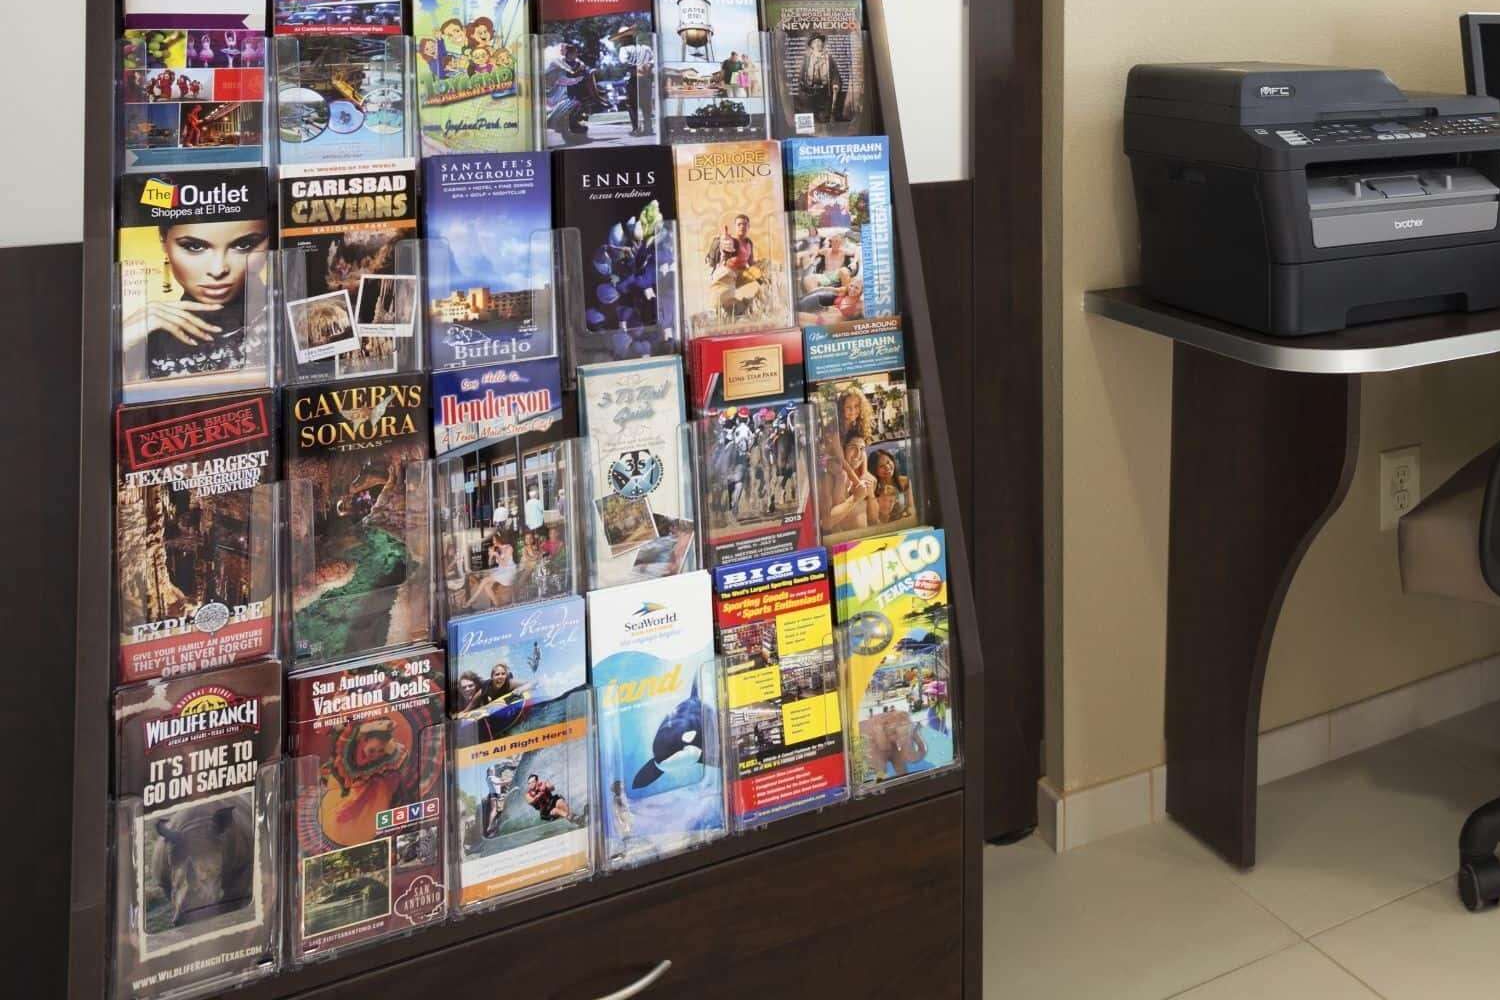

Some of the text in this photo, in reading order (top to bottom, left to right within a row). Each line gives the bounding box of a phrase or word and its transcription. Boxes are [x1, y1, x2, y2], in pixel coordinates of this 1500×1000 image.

[782, 21, 858, 31] NEW MEXICO
[1260, 86, 1290, 97] MFC
[693, 150, 766, 168] EXPLORE
[798, 142, 883, 156] SCHLITTERBAHN
[441, 159, 533, 173] SANTA FE'S
[441, 168, 536, 182] PLAYGROUND
[688, 163, 772, 182] DEMING
[291, 175, 407, 199] CARLSBAD
[582, 170, 656, 188] ENNIS
[146, 188, 171, 201] The
[180, 182, 249, 206] Outlet
[614, 188, 652, 200] tradition
[151, 204, 241, 219] Shoppes at El Paso
[291, 193, 408, 223] CAVERNS
[312, 224, 360, 233] NATIONAL
[1393, 217, 1425, 230] brother
[853, 319, 897, 331] YEAR-ROUND
[455, 338, 532, 360] Buffalo
[810, 335, 896, 355] SCHLITTERBAHN
[294, 384, 422, 423] CAVERNS
[441, 388, 552, 427] Henderson
[140, 408, 253, 442] NATURAL BRIDGE
[301, 412, 419, 449] SONORA
[140, 417, 257, 458] CAVERNS
[338, 440, 383, 452] TEXAS
[125, 450, 270, 489] TEXAS' LARGEST
[172, 467, 261, 492] UNDERGROUND
[783, 514, 802, 524] 2013
[723, 555, 822, 587] BIG 5
[846, 533, 942, 603] WACO
[721, 592, 731, 600] The
[723, 598, 761, 613] Sporting
[762, 591, 789, 604] Goods
[875, 576, 915, 609] TEXAS
[519, 606, 580, 639] Kingdom
[624, 611, 679, 633] SeaWorld
[742, 605, 773, 619] Sports
[133, 636, 263, 673] THEY'LL NEVER FORGET!
[154, 648, 176, 658] YOUR
[178, 640, 206, 653] FAMILY
[220, 629, 263, 643] ADVENTURE
[161, 652, 237, 678] OPEN DAILY
[312, 658, 431, 697] San Antonio 2013
[312, 676, 432, 717] Vacation Deals
[145, 699, 258, 750] WILDLIFE RANCH
[313, 720, 323, 730] ON
[352, 708, 382, 721] SHOPPING
[383, 707, 390, 715] &
[390, 698, 431, 713] ATTRACTIONS
[470, 749, 490, 761] It's
[492, 743, 507, 755] All
[509, 735, 540, 751] Right
[150, 739, 254, 783] IT'S TIME TO
[143, 760, 259, 808] GO ON SAFARI!
[402, 890, 442, 913] ANTONIO
[413, 884, 431, 898] SAN
